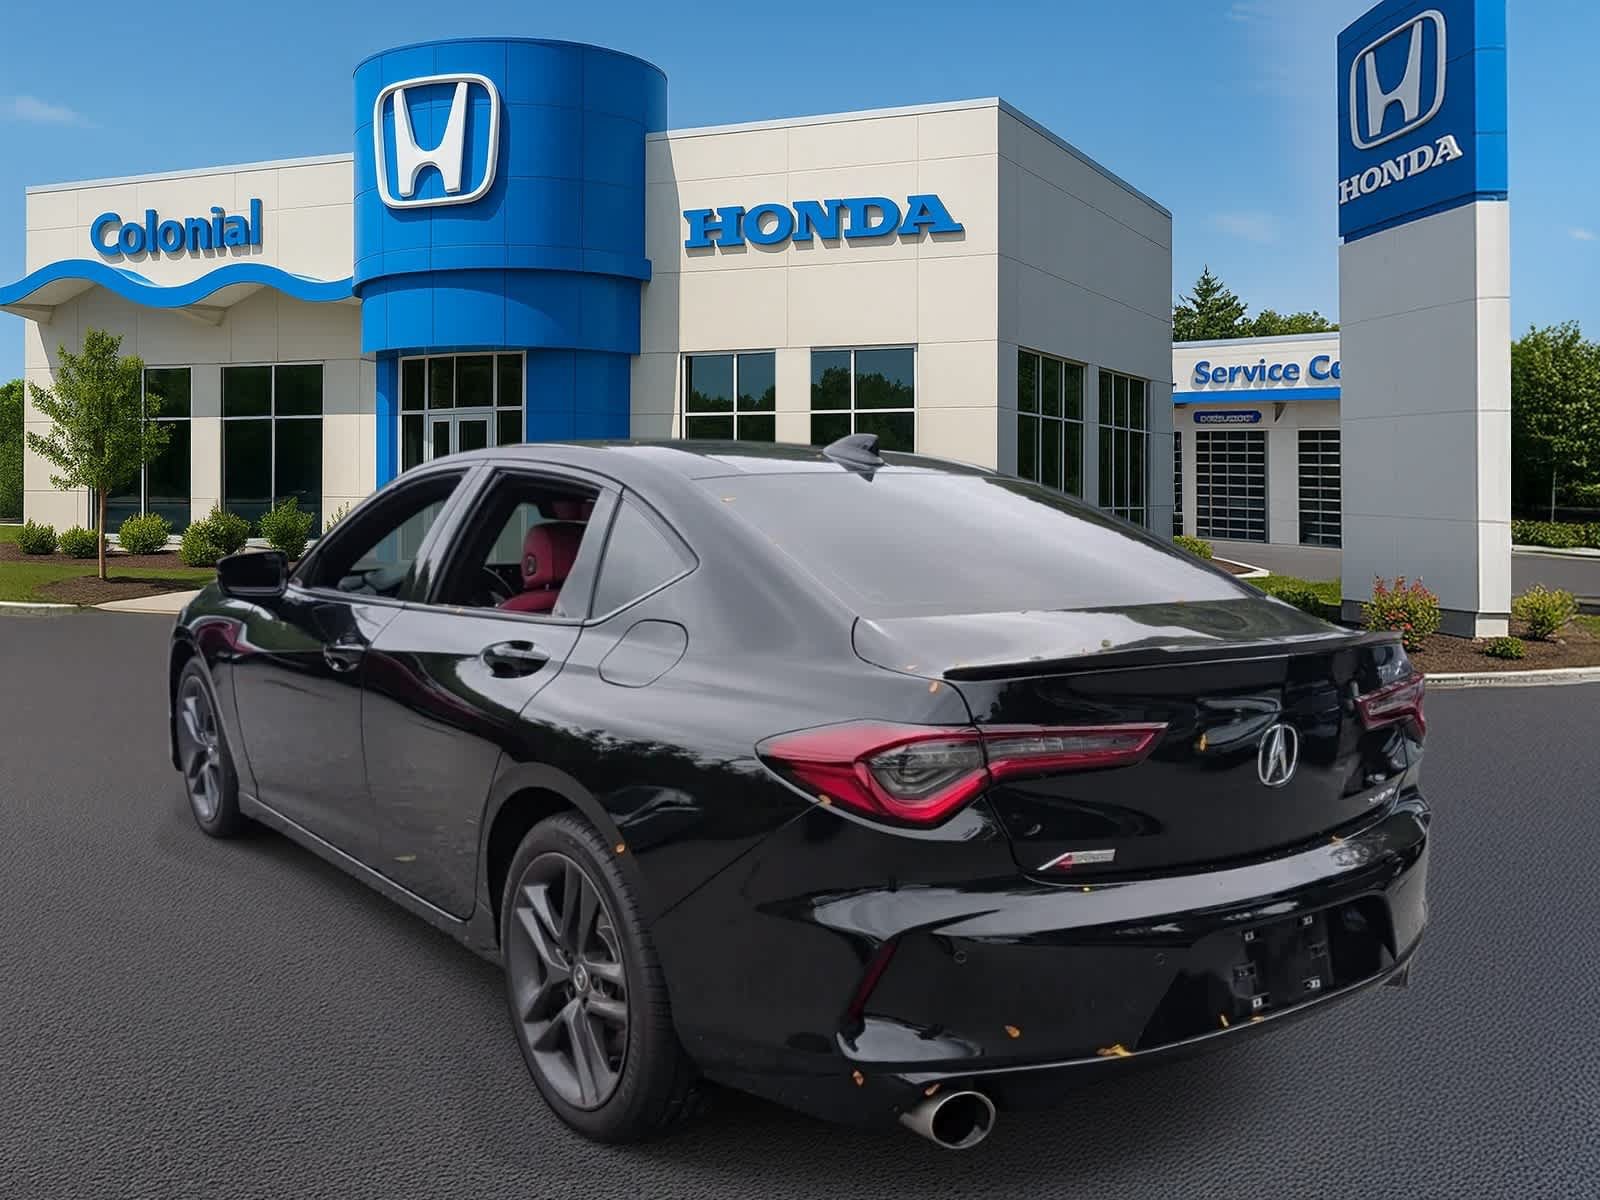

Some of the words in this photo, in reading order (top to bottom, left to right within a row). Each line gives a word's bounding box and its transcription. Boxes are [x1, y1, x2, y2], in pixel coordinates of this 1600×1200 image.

[1339, 134, 1463, 204] HONDA
[90, 198, 263, 258] Colonial
[683, 194, 963, 248] HONDA
[1194, 358, 1300, 385] Service
